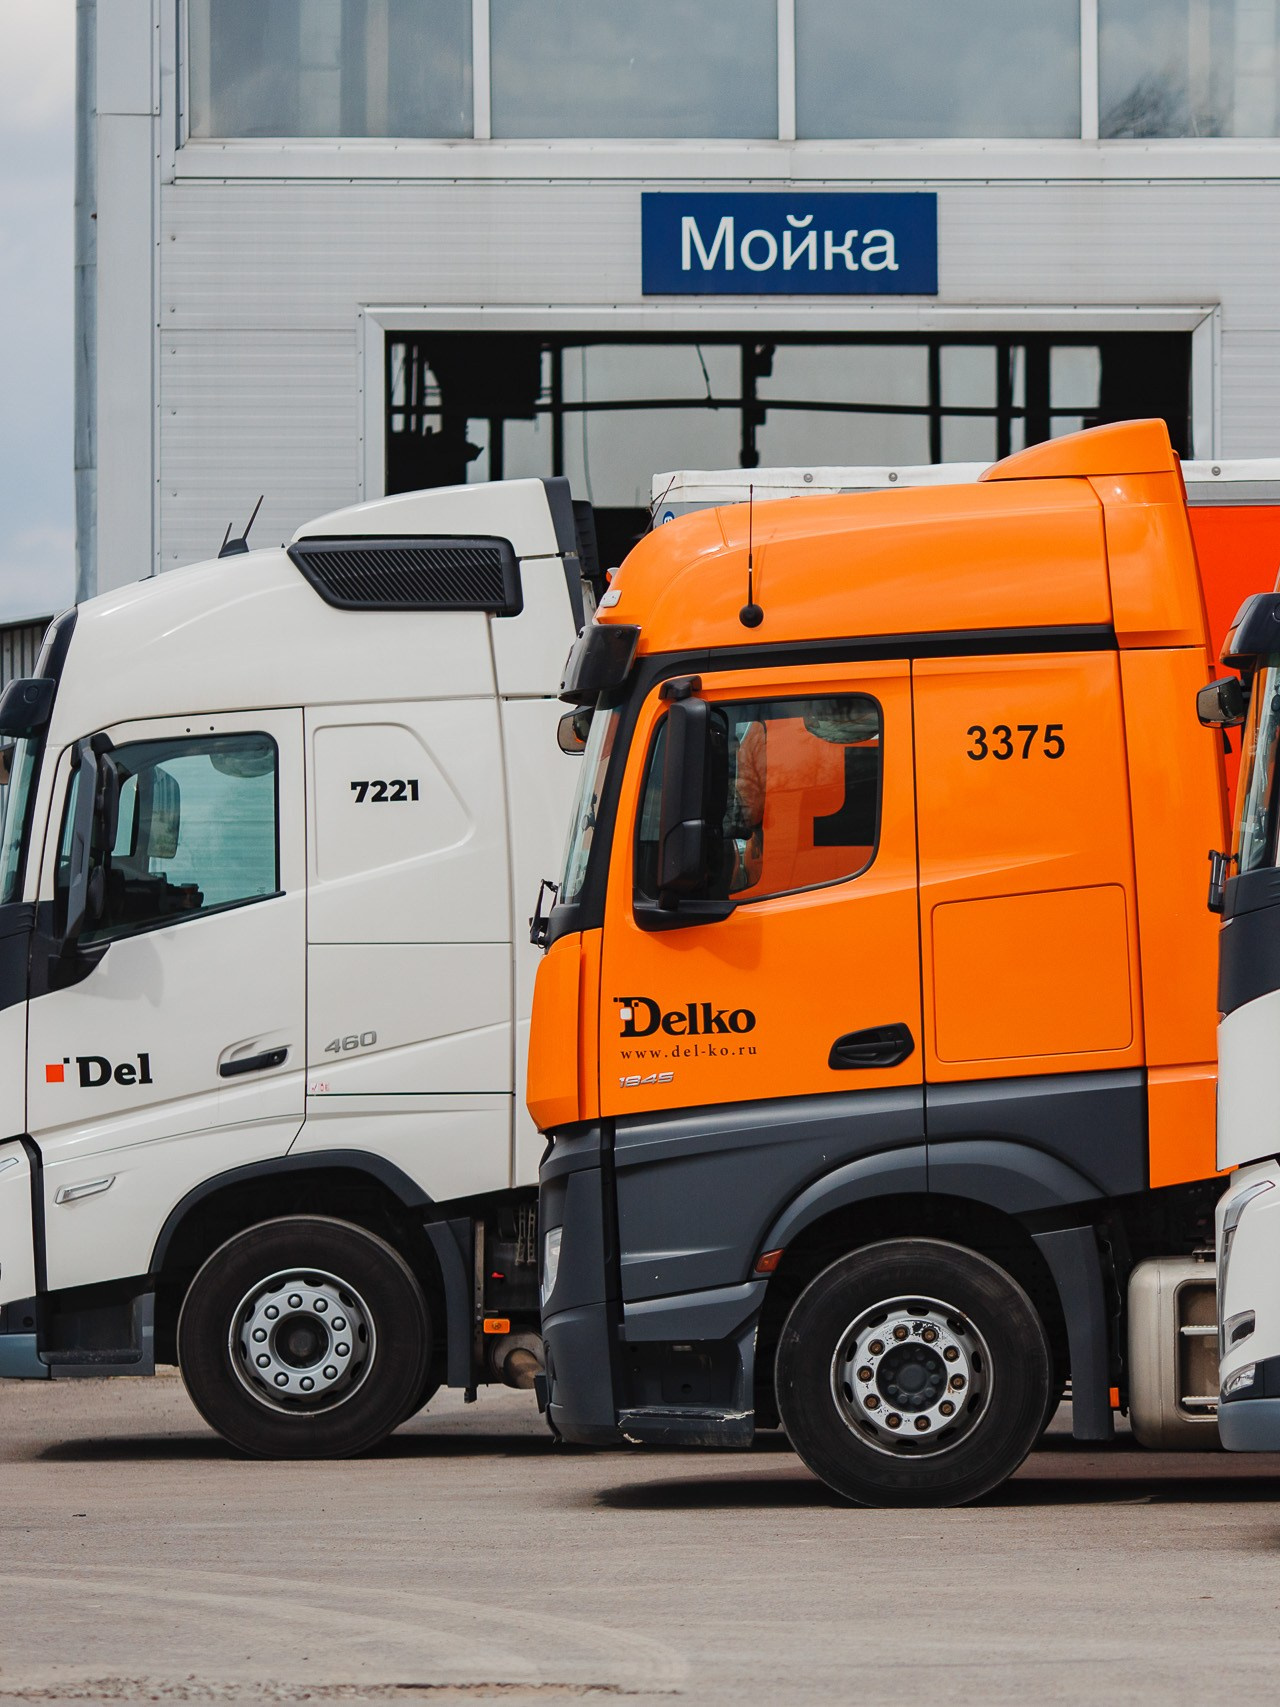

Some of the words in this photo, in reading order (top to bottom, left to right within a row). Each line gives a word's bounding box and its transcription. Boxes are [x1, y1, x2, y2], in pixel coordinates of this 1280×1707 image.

[681, 214, 899, 271] Мойка
[966, 724, 1065, 760] 3375
[350, 779, 419, 803] 7221
[615, 997, 756, 1037] Delko
[324, 1031, 377, 1053] 460
[621, 1044, 757, 1059] www.del-ko.ru
[76, 1053, 153, 1087] Del
[618, 1071, 674, 1088] 1845
